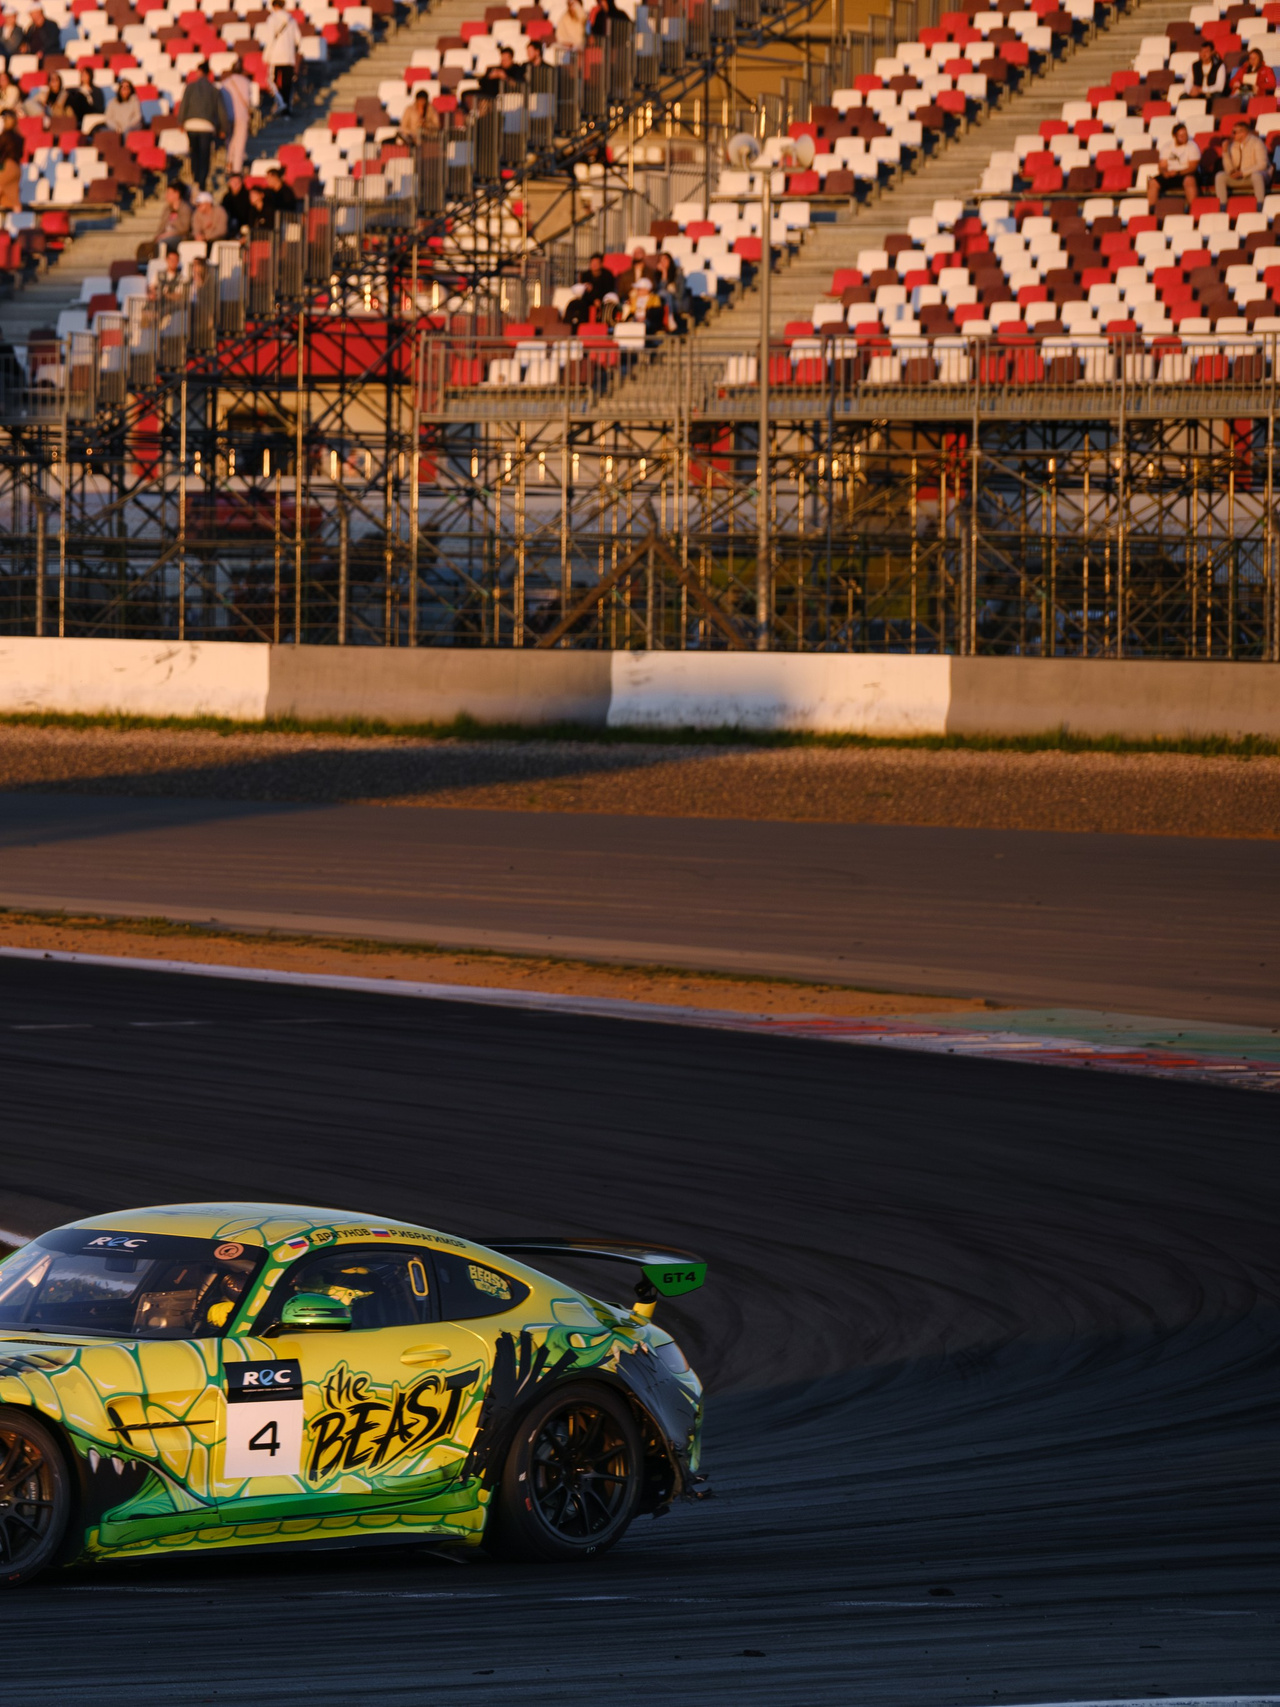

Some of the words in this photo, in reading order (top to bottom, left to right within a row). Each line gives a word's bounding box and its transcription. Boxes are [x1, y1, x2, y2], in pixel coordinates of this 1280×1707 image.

[318, 1228, 371, 1243] ДРАГУНОВ
[467, 1264, 509, 1292] BEAST
[662, 1271, 697, 1284] GT4
[324, 1365, 370, 1410] the
[248, 1420, 281, 1457] 4
[309, 1366, 481, 1482] BEAST
